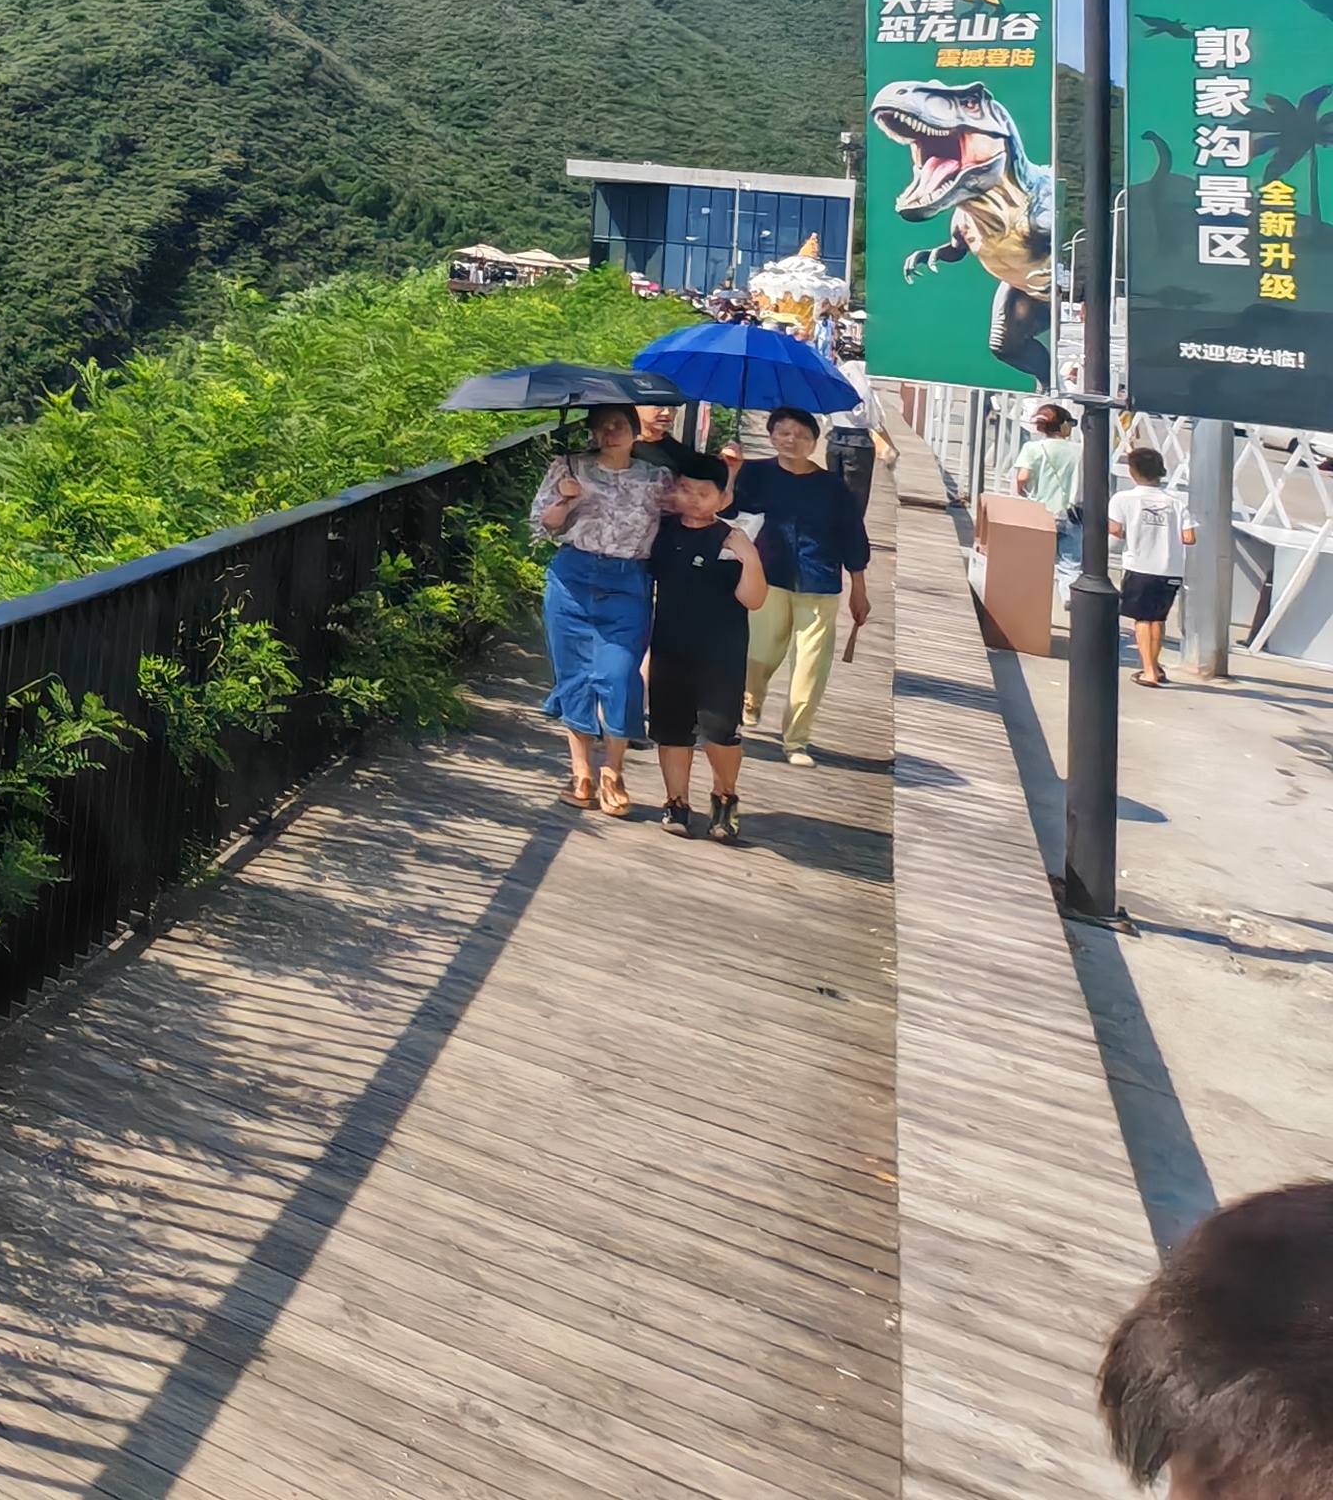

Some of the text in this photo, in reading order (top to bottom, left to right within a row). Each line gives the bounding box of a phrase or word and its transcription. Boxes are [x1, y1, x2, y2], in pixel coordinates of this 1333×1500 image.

[876, 13, 1042, 43] 恐龙山谷
[935, 47, 1036, 68] 震撼登陆
[1194, 27, 1252, 267] 郭家沟景区
[1259, 180, 1297, 300] 全新升级
